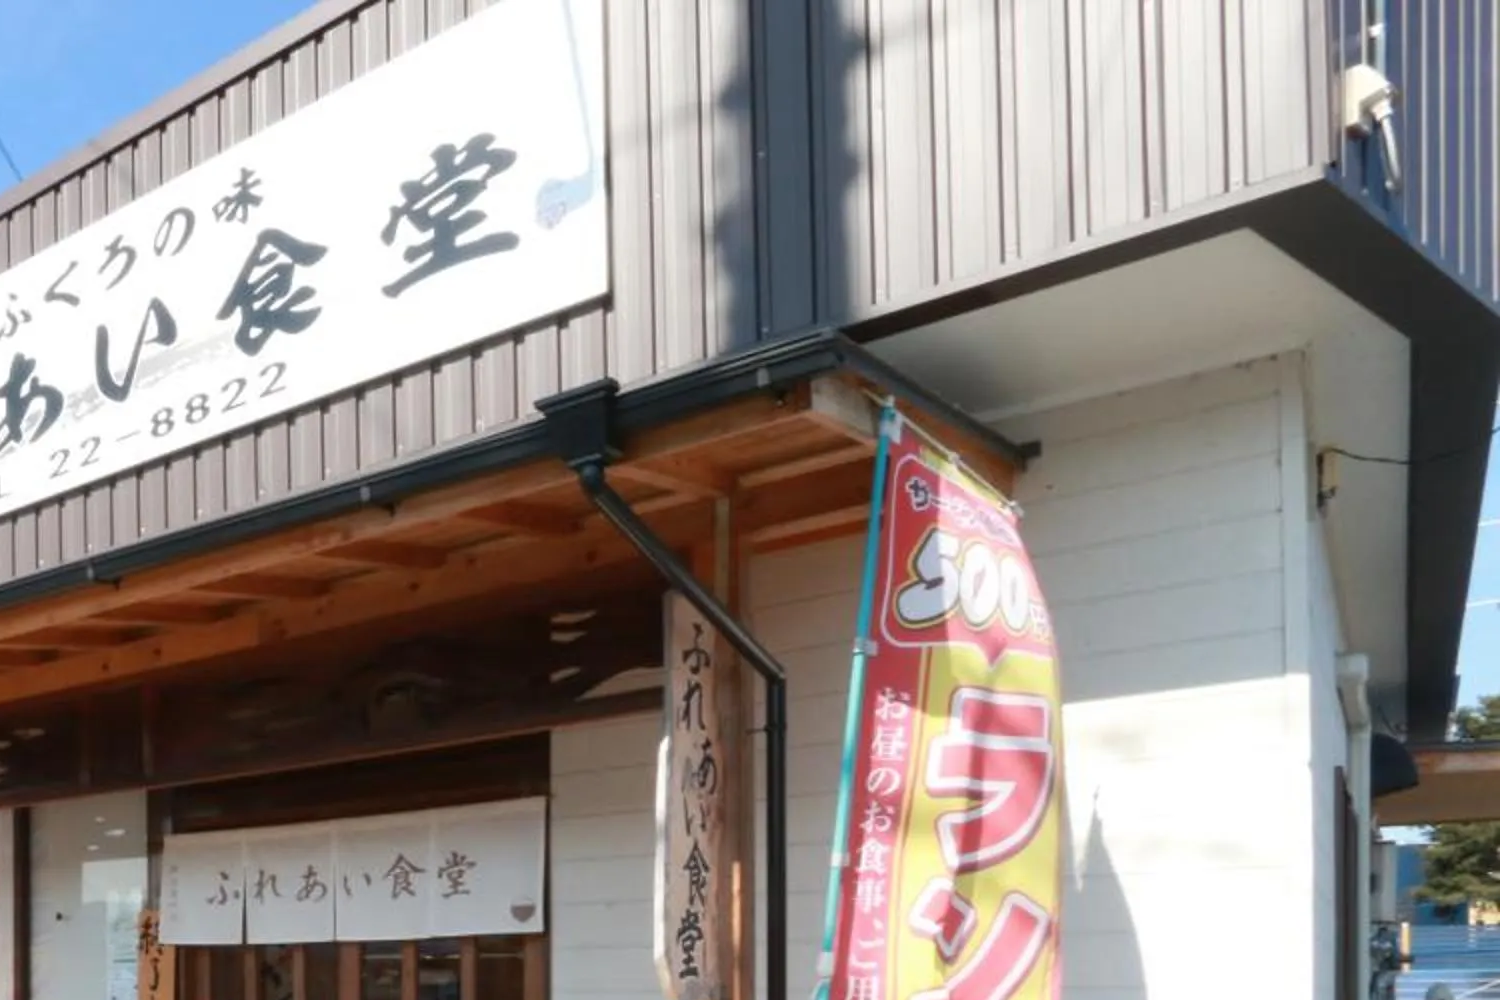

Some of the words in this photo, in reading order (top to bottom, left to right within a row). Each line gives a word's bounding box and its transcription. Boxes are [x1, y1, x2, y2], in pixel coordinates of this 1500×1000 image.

[49, 362, 288, 480] 22-8822
[674, 622, 718, 981] ふれあい食堂
[205, 850, 479, 906] ふれあい食堂
